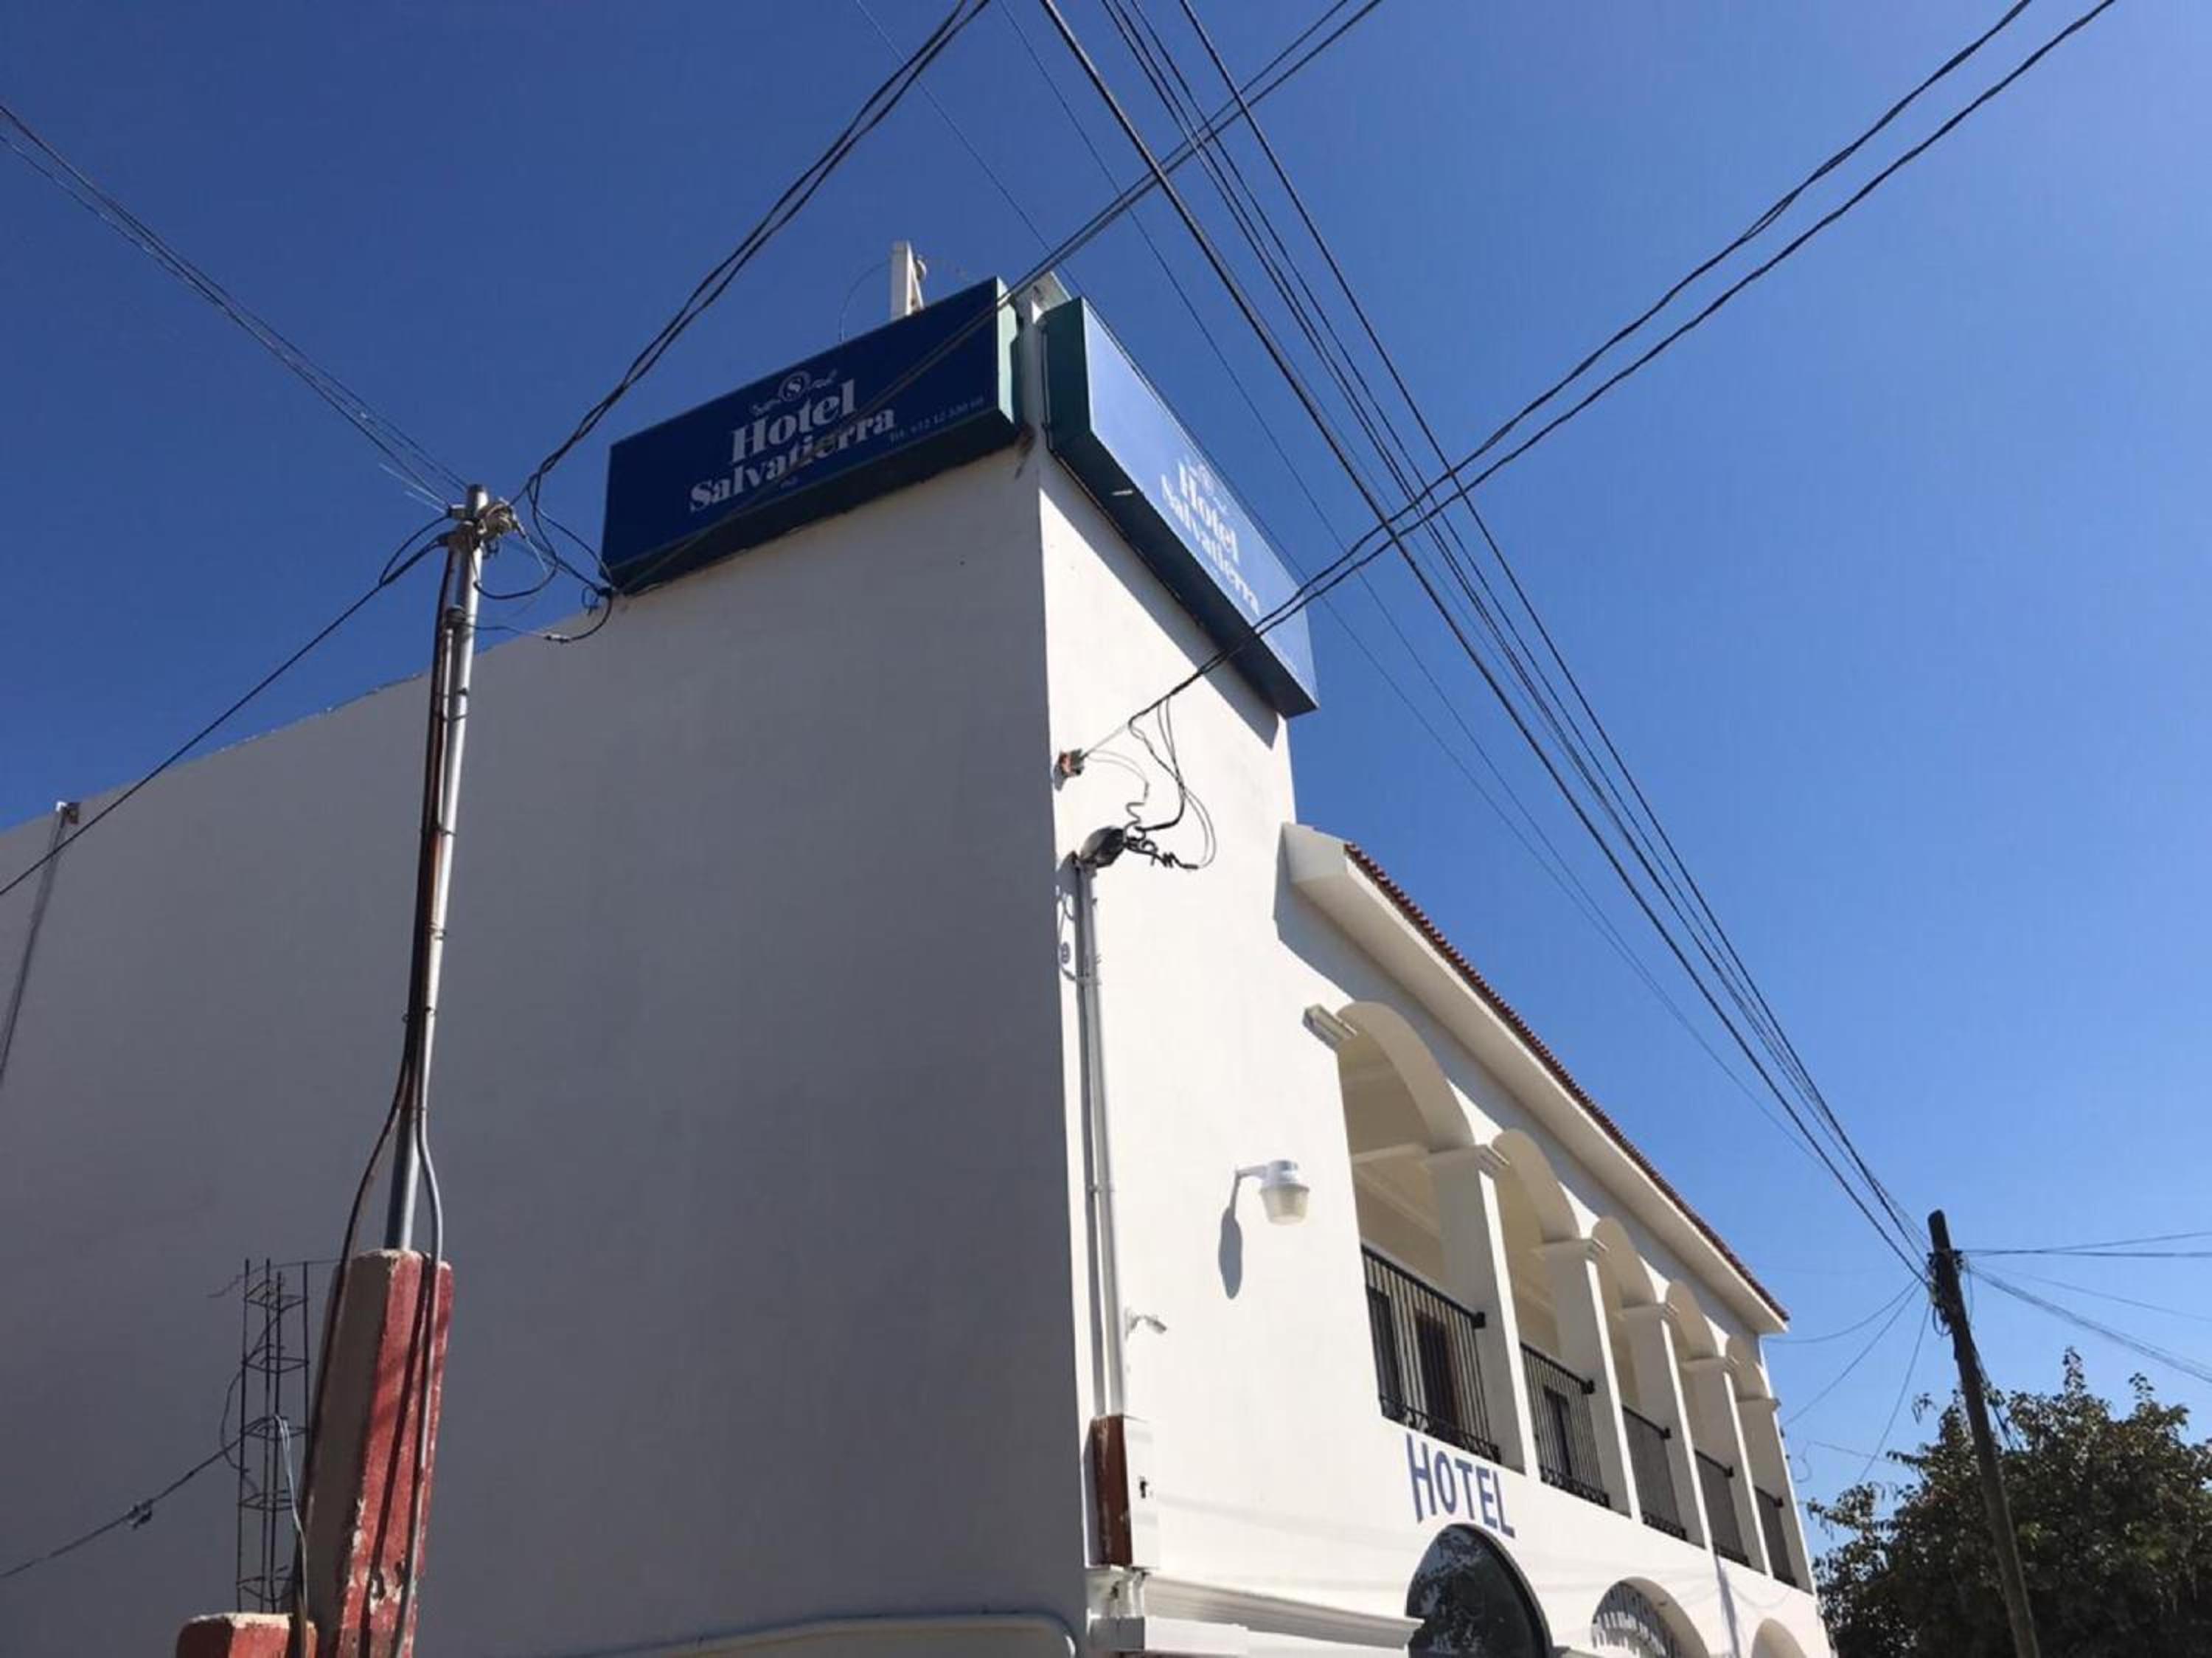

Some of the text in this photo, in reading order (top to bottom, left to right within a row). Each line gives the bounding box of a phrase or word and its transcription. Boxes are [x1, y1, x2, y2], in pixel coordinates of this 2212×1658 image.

[729, 378, 859, 465] Hotel
[786, 377, 803, 398] S
[689, 407, 895, 513] Salvatierra
[1178, 459, 1240, 566] Hotel
[1406, 1433, 1516, 1539] HOTEL
